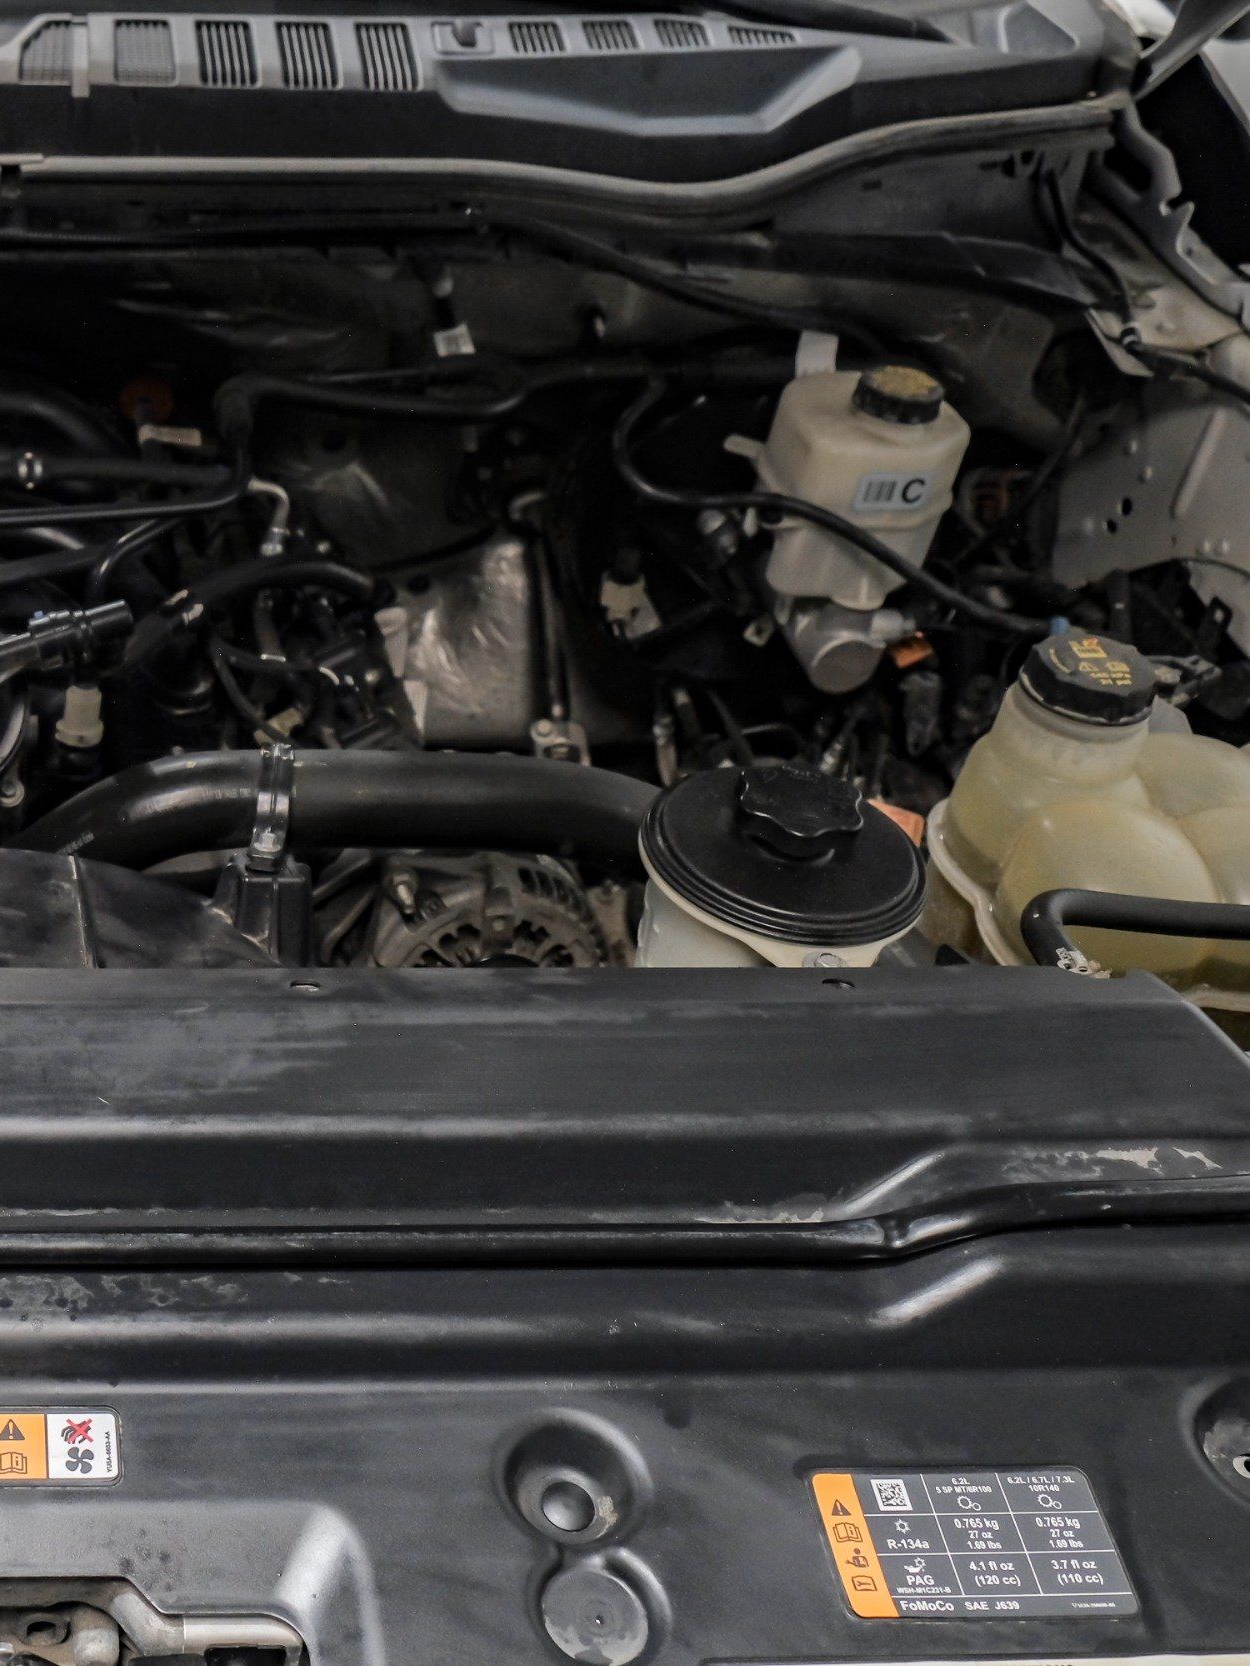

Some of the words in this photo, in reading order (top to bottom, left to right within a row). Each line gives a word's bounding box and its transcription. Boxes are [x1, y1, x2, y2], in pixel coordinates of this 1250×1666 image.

[902, 478, 927, 504] C
[951, 1477, 970, 1485] 6.2L
[1007, 1476, 1026, 1484] 6.2L
[1031, 1476, 1050, 1484] 6.7L
[1055, 1475, 1075, 1483] 7.3L
[942, 1485, 953, 1494] SP
[1028, 1484, 1060, 1492] 10R140
[953, 1517, 983, 1529] 0.765
[983, 1517, 1000, 1531] kg
[1035, 1516, 1065, 1528] 0.765
[1064, 1516, 1081, 1529] kg
[968, 1530, 979, 1539] 27
[981, 1531, 993, 1539] oz
[1049, 1529, 1060, 1538] 27
[1062, 1530, 1075, 1538] oz
[886, 1538, 930, 1550] R-134a
[967, 1540, 986, 1550] 1.69
[986, 1540, 1002, 1549] lbs
[1049, 1539, 1068, 1549] 1.69
[1068, 1539, 1084, 1548] lbs
[969, 1560, 987, 1571] 4.1
[999, 1562, 1015, 1571] oz
[1050, 1559, 1068, 1570] 3.7
[1081, 1561, 1098, 1569] oz
[906, 1574, 935, 1586] PAG
[974, 1574, 1000, 1588] (120
[1001, 1574, 1021, 1587] cc)
[1057, 1573, 1083, 1586] (110
[1084, 1572, 1104, 1586] cc)
[899, 1599, 955, 1612] FoMoCo
[964, 1600, 990, 1611] SAE
[994, 1600, 1020, 1610] J639
